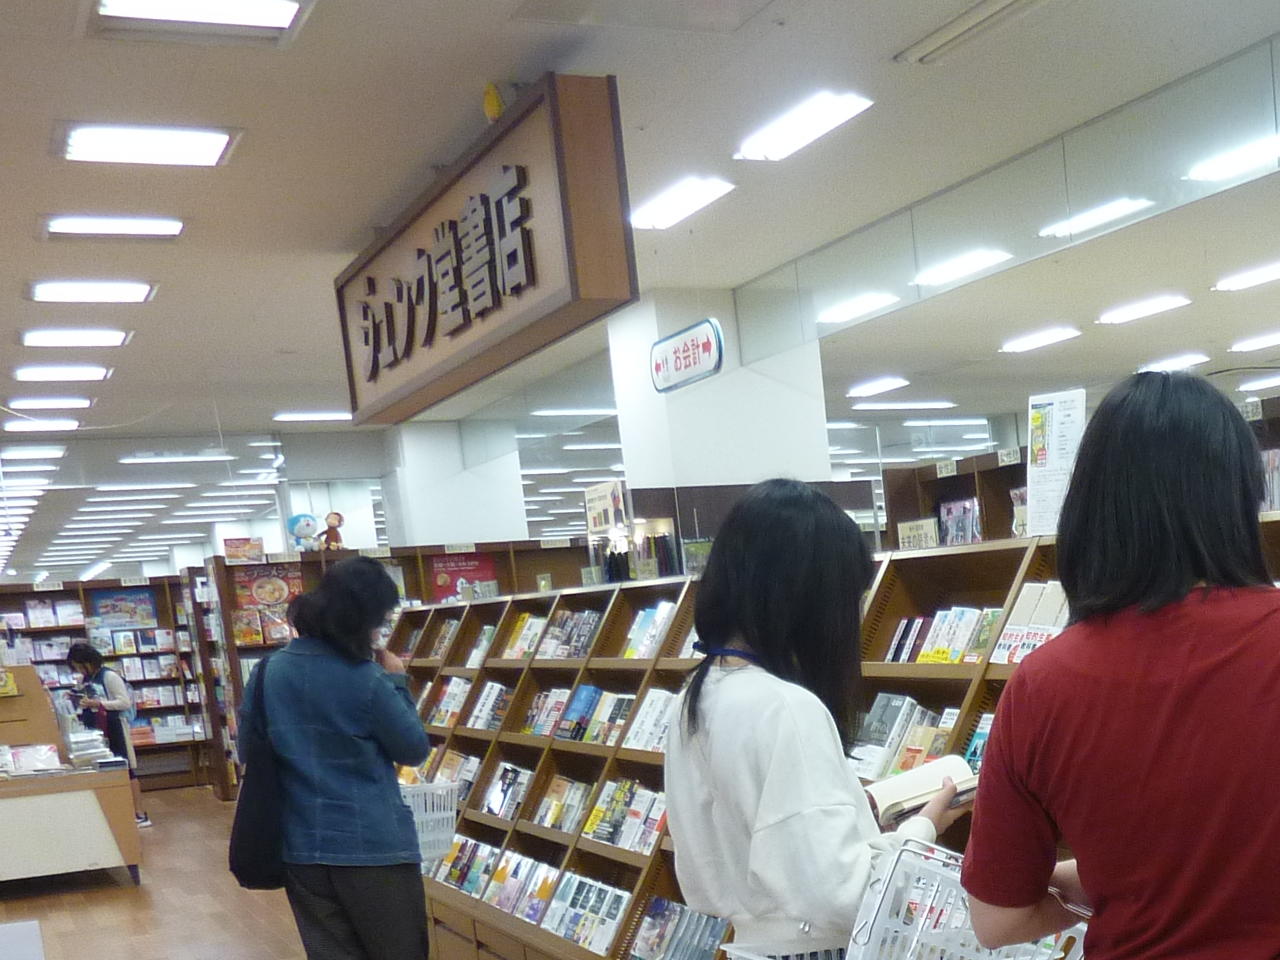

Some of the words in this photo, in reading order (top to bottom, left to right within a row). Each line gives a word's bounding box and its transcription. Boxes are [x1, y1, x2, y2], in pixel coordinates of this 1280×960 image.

[361, 165, 537, 384] ジュンク堂書店
[673, 337, 701, 372] お会計
